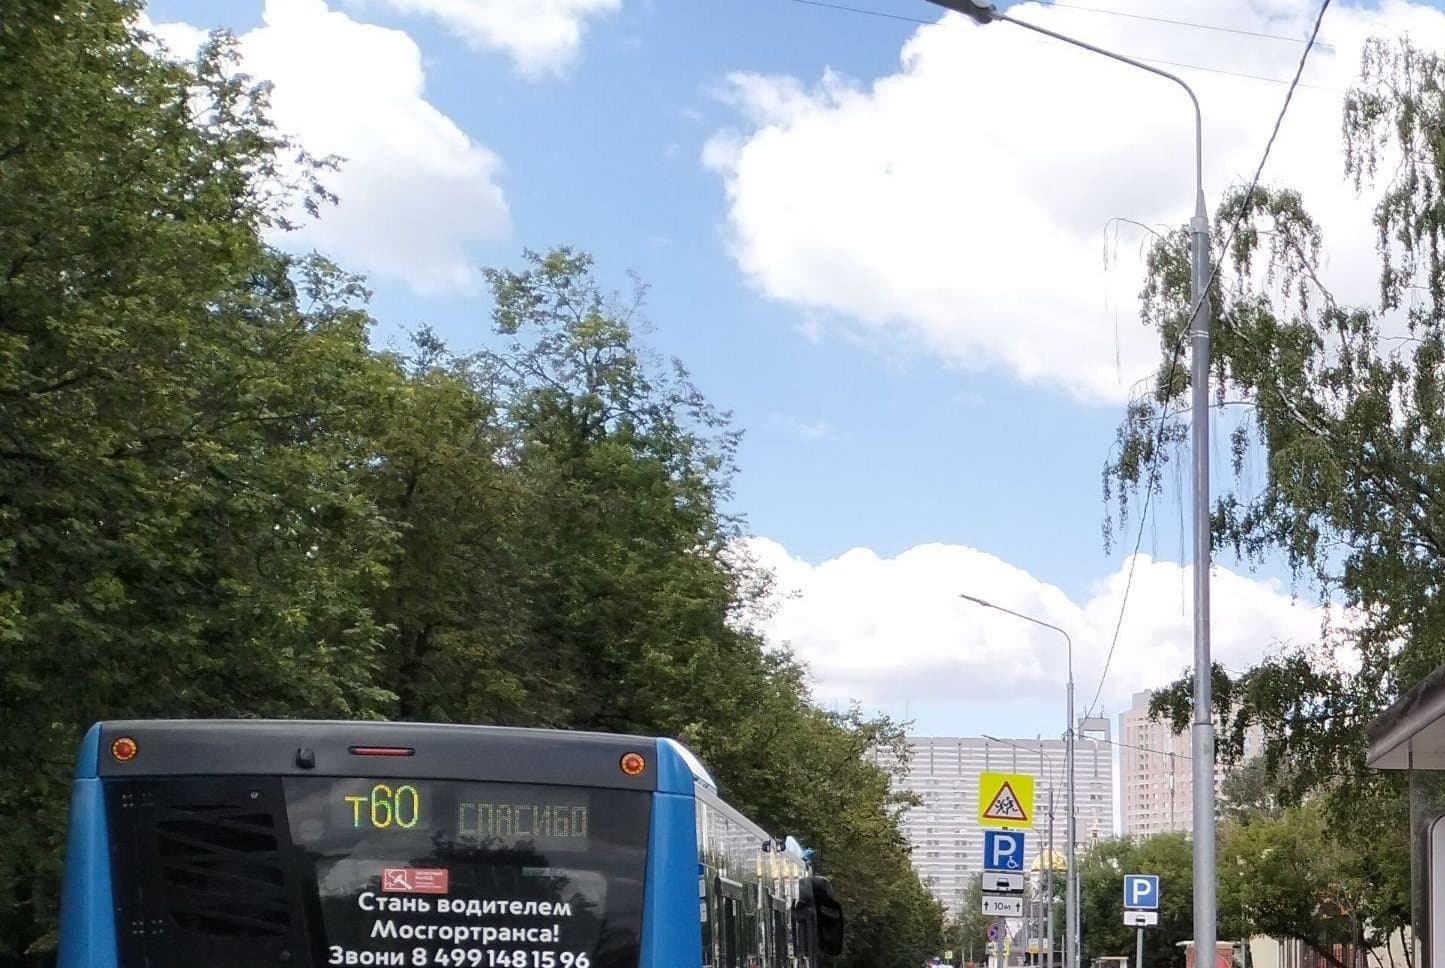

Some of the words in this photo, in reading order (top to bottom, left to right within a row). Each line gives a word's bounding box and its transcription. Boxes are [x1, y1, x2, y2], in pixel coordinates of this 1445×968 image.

[458, 803, 588, 837] СПАСИБО
[993, 835, 1017, 866] P
[1133, 879, 1151, 904] P
[358, 892, 430, 913] Стань
[436, 897, 572, 917] водителем
[994, 902, 1011, 911] 10м
[370, 920, 560, 945] Мосгортранса!
[328, 945, 404, 966] Звони
[411, 947, 428, 967] 8
[434, 948, 482, 968] 499
[488, 949, 527, 968] 148
[533, 950, 555, 968] 15
